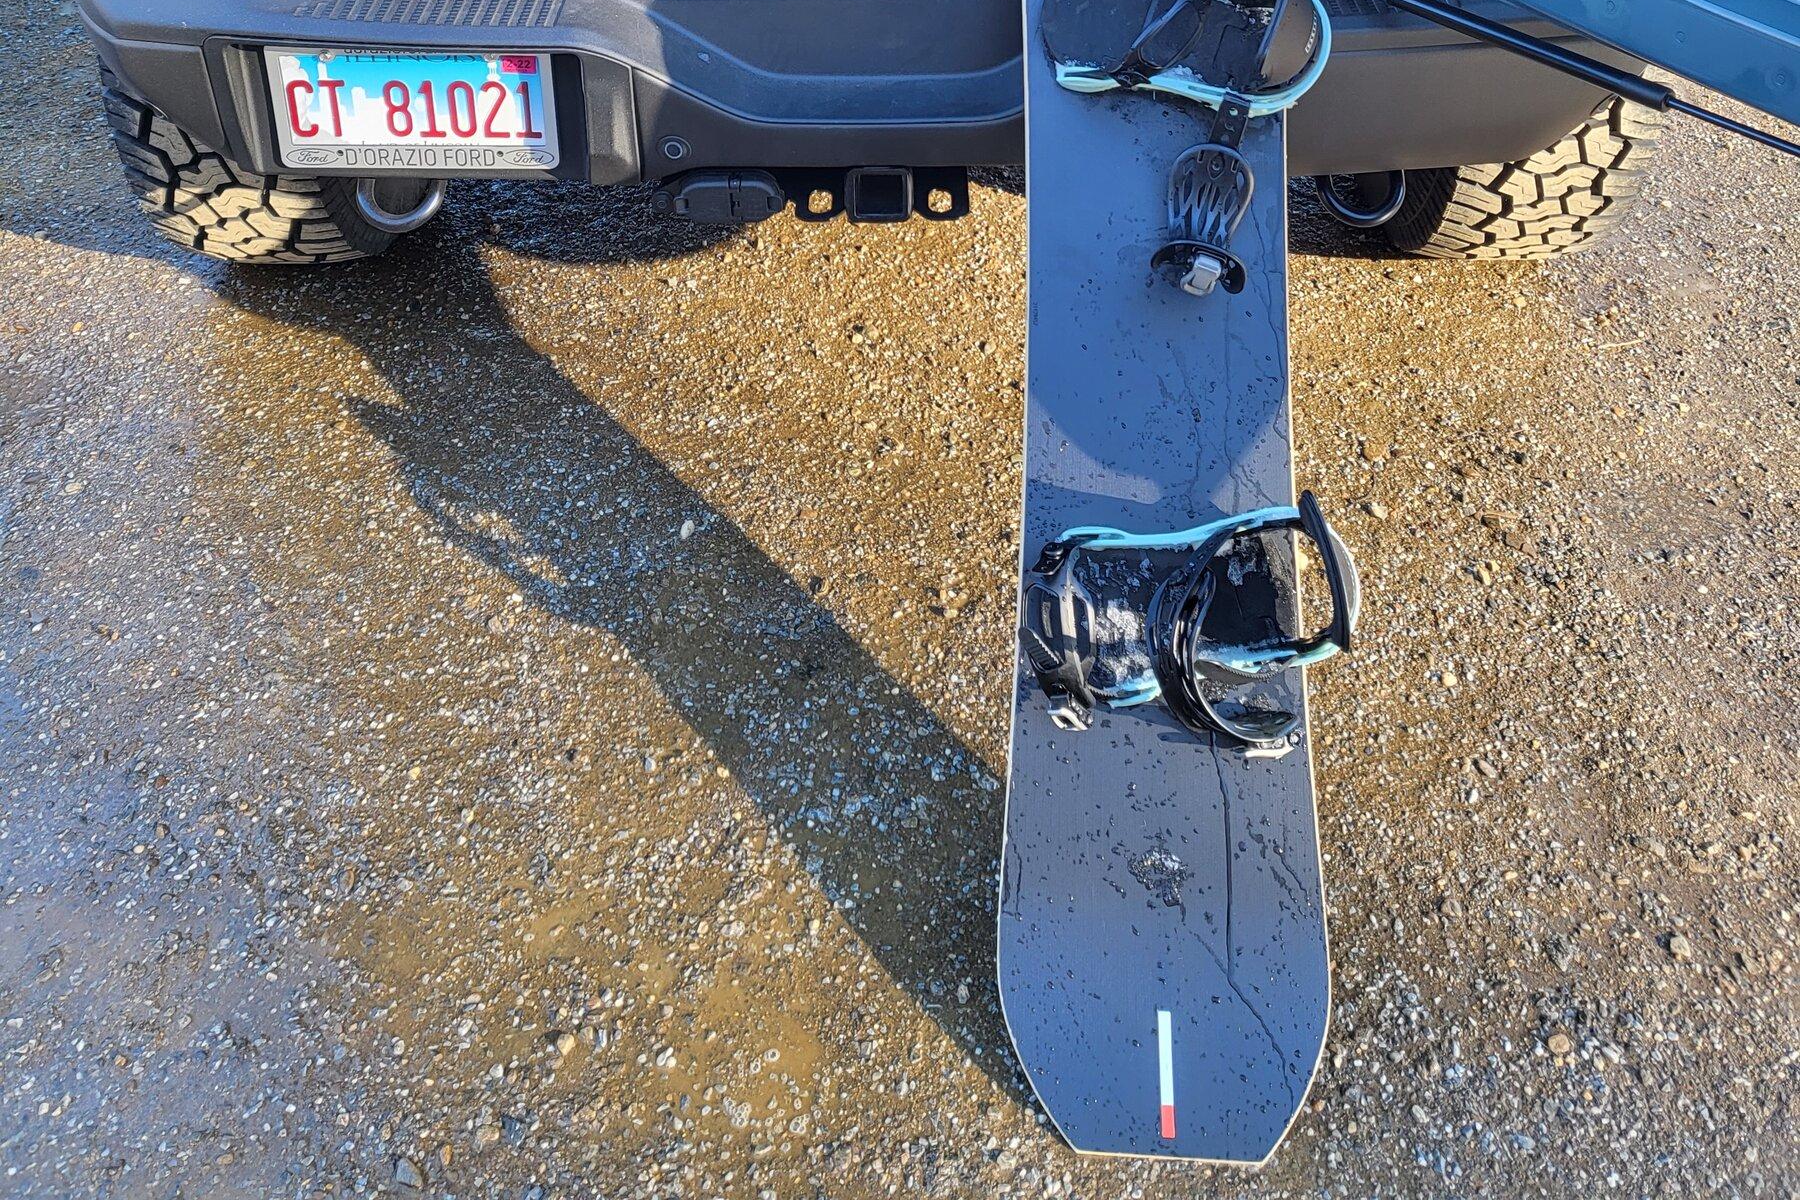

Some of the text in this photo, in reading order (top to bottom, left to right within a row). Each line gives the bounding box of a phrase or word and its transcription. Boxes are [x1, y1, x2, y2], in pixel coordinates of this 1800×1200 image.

[286, 79, 543, 139] CT 81021
[297, 147, 544, 167] Ford D'ORAZIO FORD Ford
